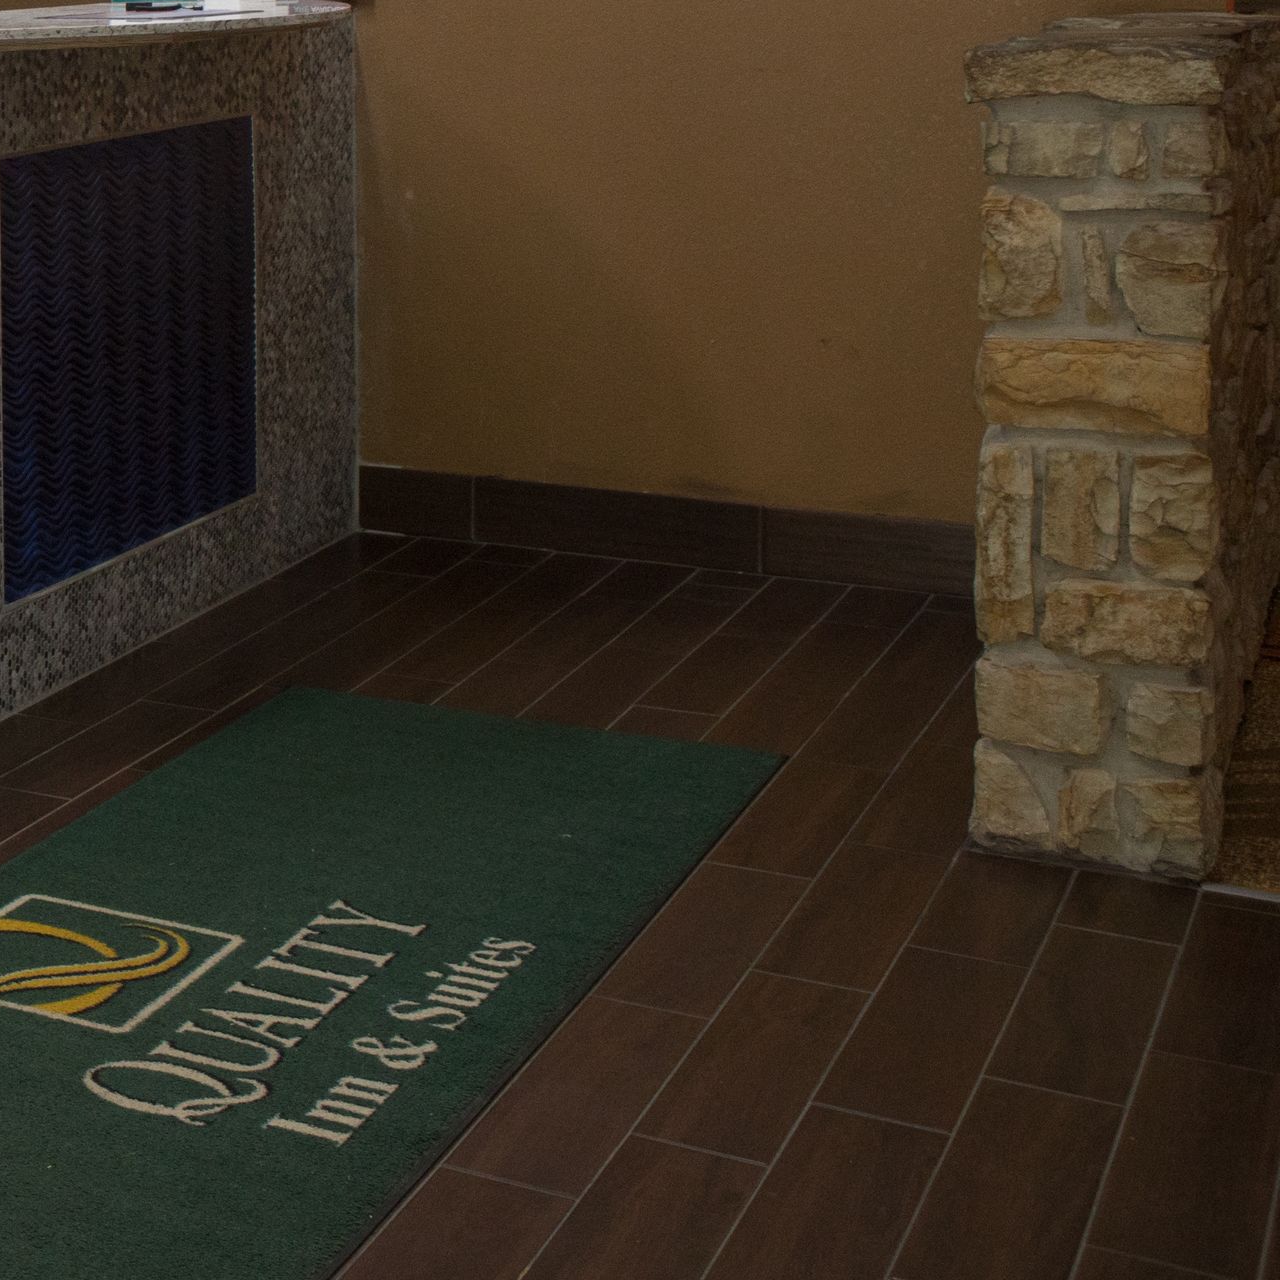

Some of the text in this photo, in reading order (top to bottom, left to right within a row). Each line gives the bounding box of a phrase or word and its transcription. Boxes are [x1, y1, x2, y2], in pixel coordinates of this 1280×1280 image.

[83, 899, 427, 1126] QUALITY
[264, 934, 537, 1147] Inn & Suites
